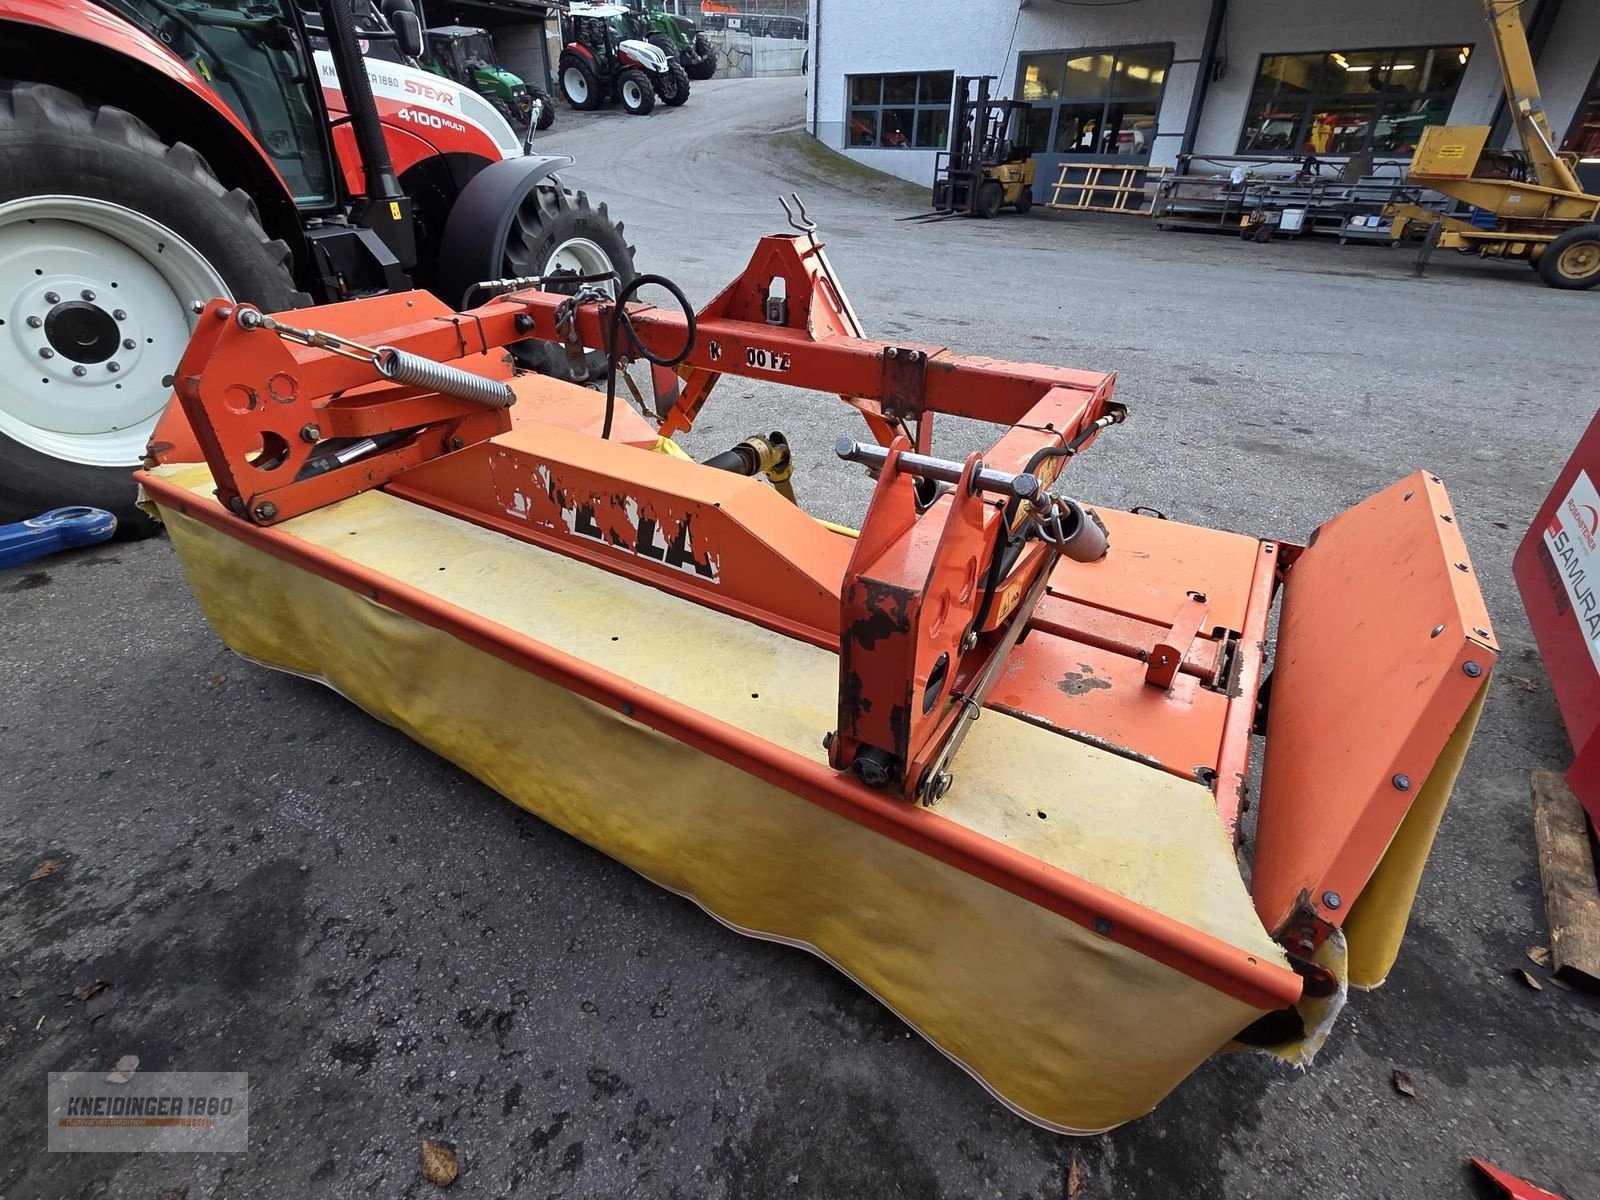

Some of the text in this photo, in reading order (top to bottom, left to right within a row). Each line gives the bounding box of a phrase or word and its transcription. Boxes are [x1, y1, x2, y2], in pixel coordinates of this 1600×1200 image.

[379, 75, 399, 87] 1880
[404, 79, 454, 106] STEYR
[398, 108, 466, 133] 4100 MULTI
